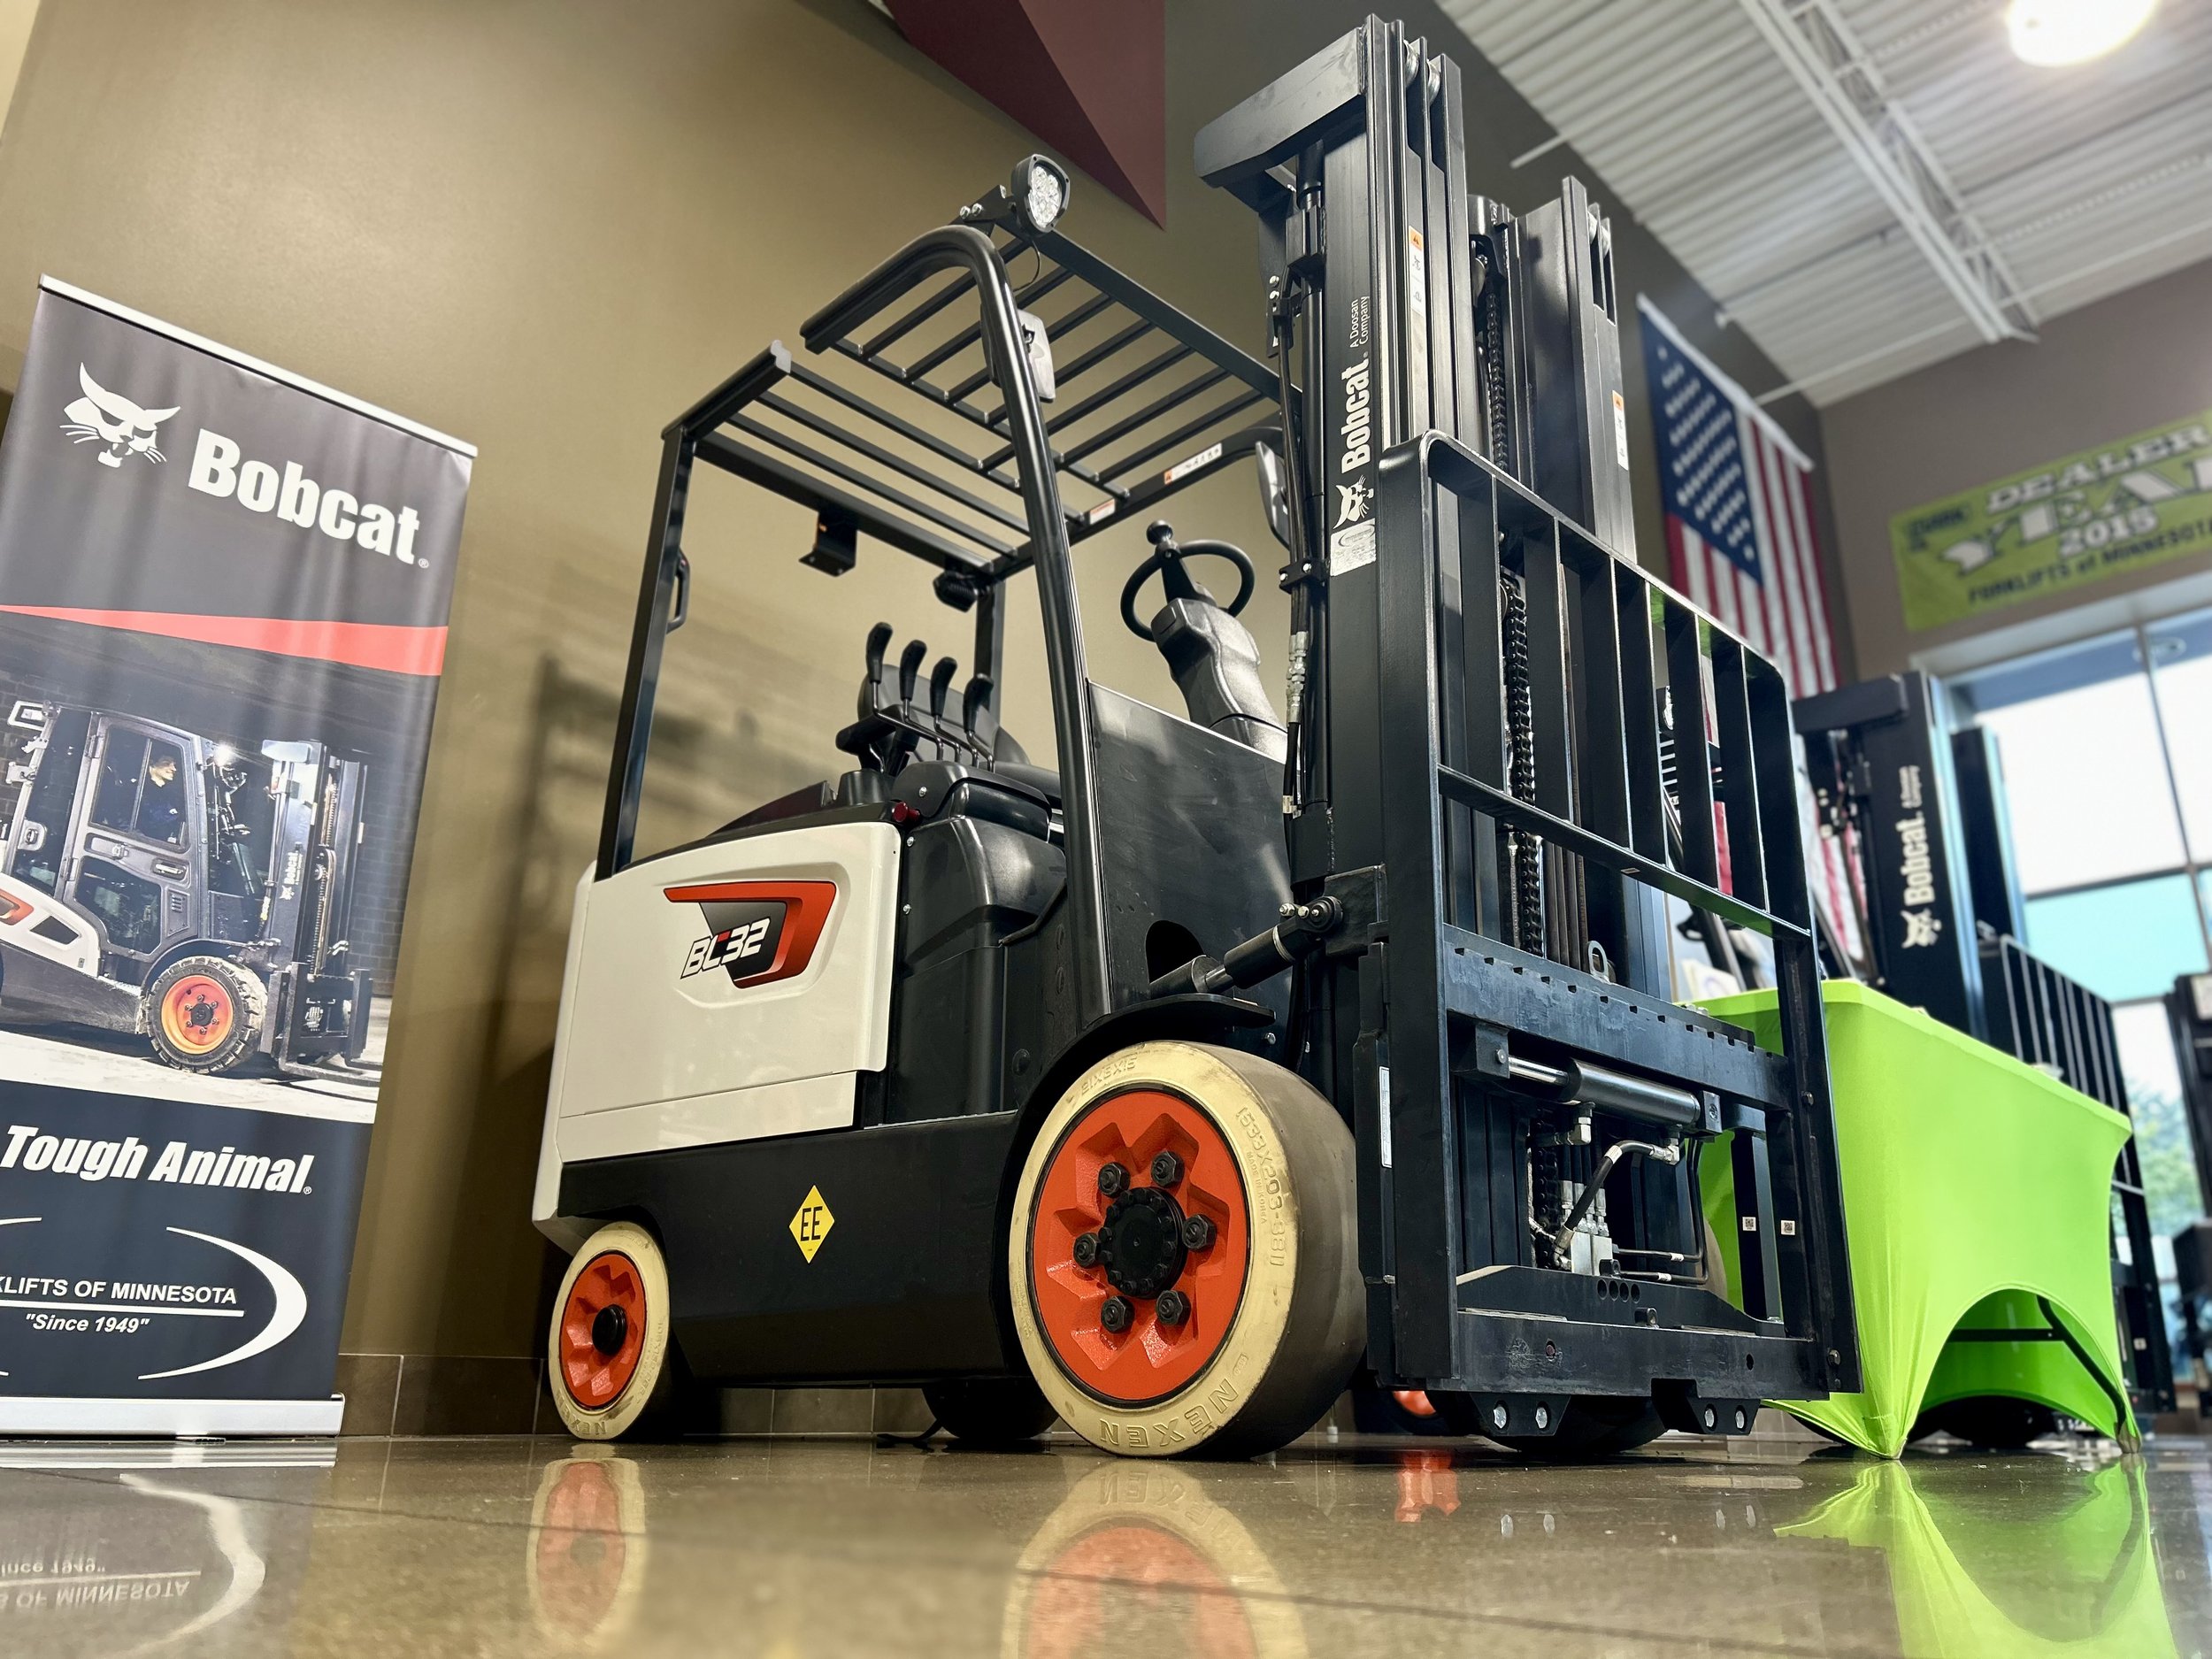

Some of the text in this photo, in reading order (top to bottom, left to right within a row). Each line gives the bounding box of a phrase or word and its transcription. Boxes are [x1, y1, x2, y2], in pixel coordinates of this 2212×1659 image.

[1349, 298, 1359, 349] A Doosan
[1359, 296, 1370, 345] Company
[1340, 358, 1371, 473] Bobcat
[188, 427, 420, 565] Bobcat
[1985, 425, 2210, 515] DEALER
[2059, 504, 2159, 558] 2015
[1895, 816, 1936, 906] Bobcat
[680, 917, 771, 979] BC32
[0, 1125, 315, 1194] Tough Animal
[800, 1206, 823, 1242] EE
[26, 1313, 150, 1333] "Since 1949"
[74, 1280, 107, 1298] OF
[111, 1282, 237, 1304] MINNESOTA
[1100, 1378, 1239, 1448] NEXEN
